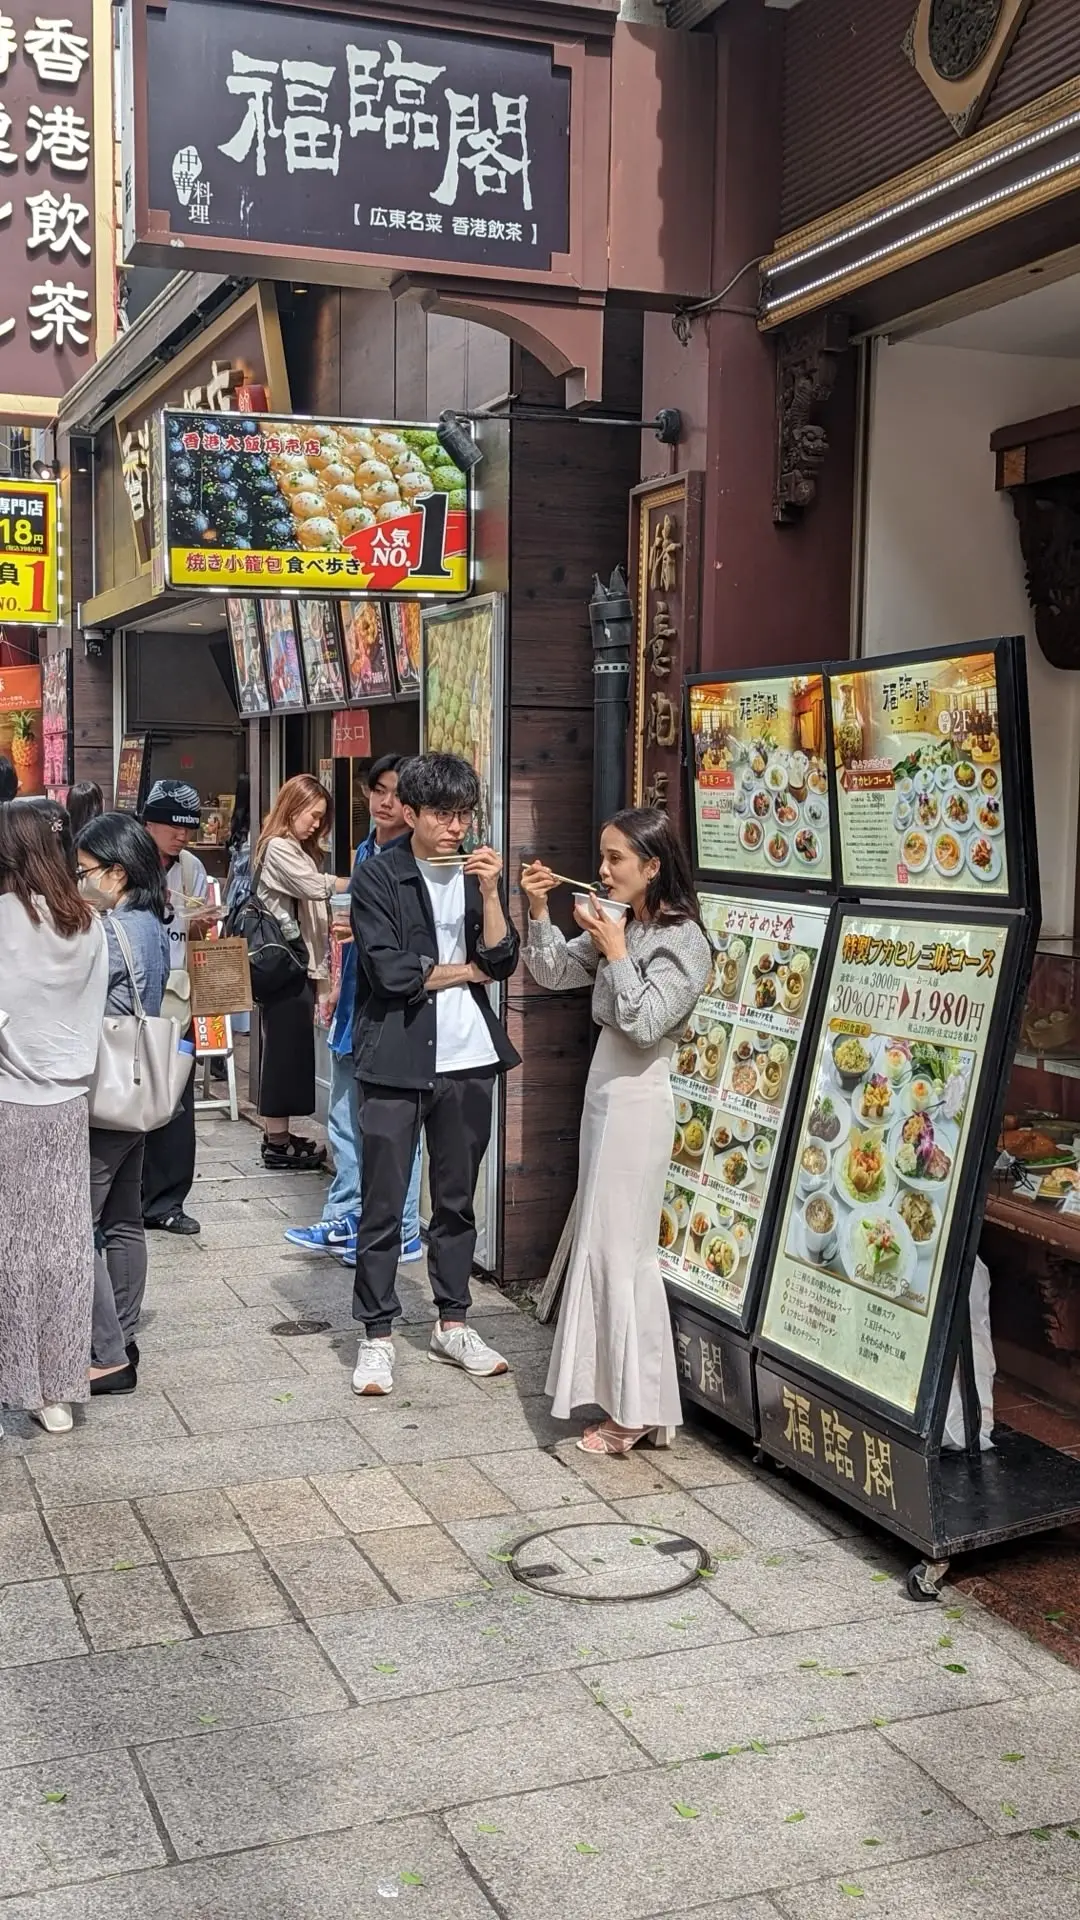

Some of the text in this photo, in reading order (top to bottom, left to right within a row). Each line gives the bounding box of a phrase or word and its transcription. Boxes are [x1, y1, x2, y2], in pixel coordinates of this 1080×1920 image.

[218, 40, 534, 210] 福臨閣
[24, 17, 91, 345] 香港飲茶
[182, 432, 322, 456] 香港大飯店売店
[370, 527, 411, 547] 人気
[371, 491, 453, 578] NO. 1
[725, 910, 795, 940] おすすめ定食
[842, 933, 996, 978] 特製フカヒレ三味コース
[833, 984, 899, 1021] 30%OFF
[910, 988, 985, 1032] 1,980円
[783, 1385, 897, 1511] 福臨閣
